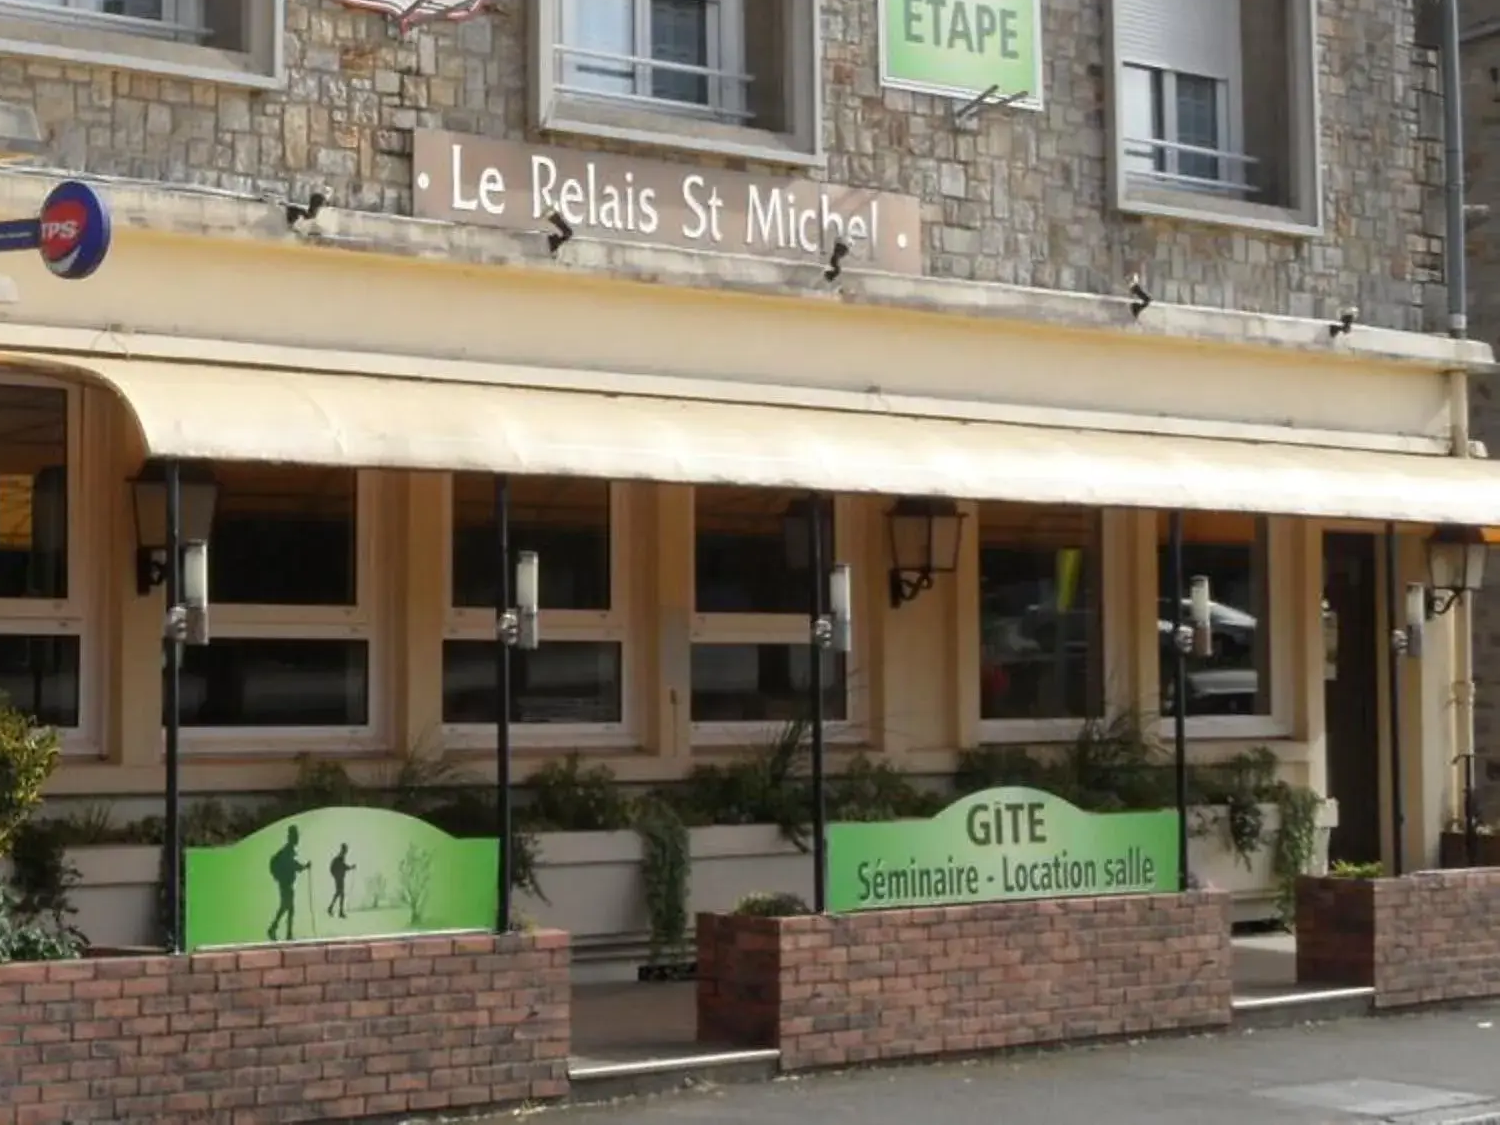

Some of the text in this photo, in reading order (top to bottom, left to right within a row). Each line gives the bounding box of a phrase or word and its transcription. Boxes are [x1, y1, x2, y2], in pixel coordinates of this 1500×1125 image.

[452, 144, 878, 259] Le Relais St Michel
[857, 856, 979, 901] Séminaire
[1002, 851, 1097, 893] Location
[1104, 847, 1155, 887] salle
